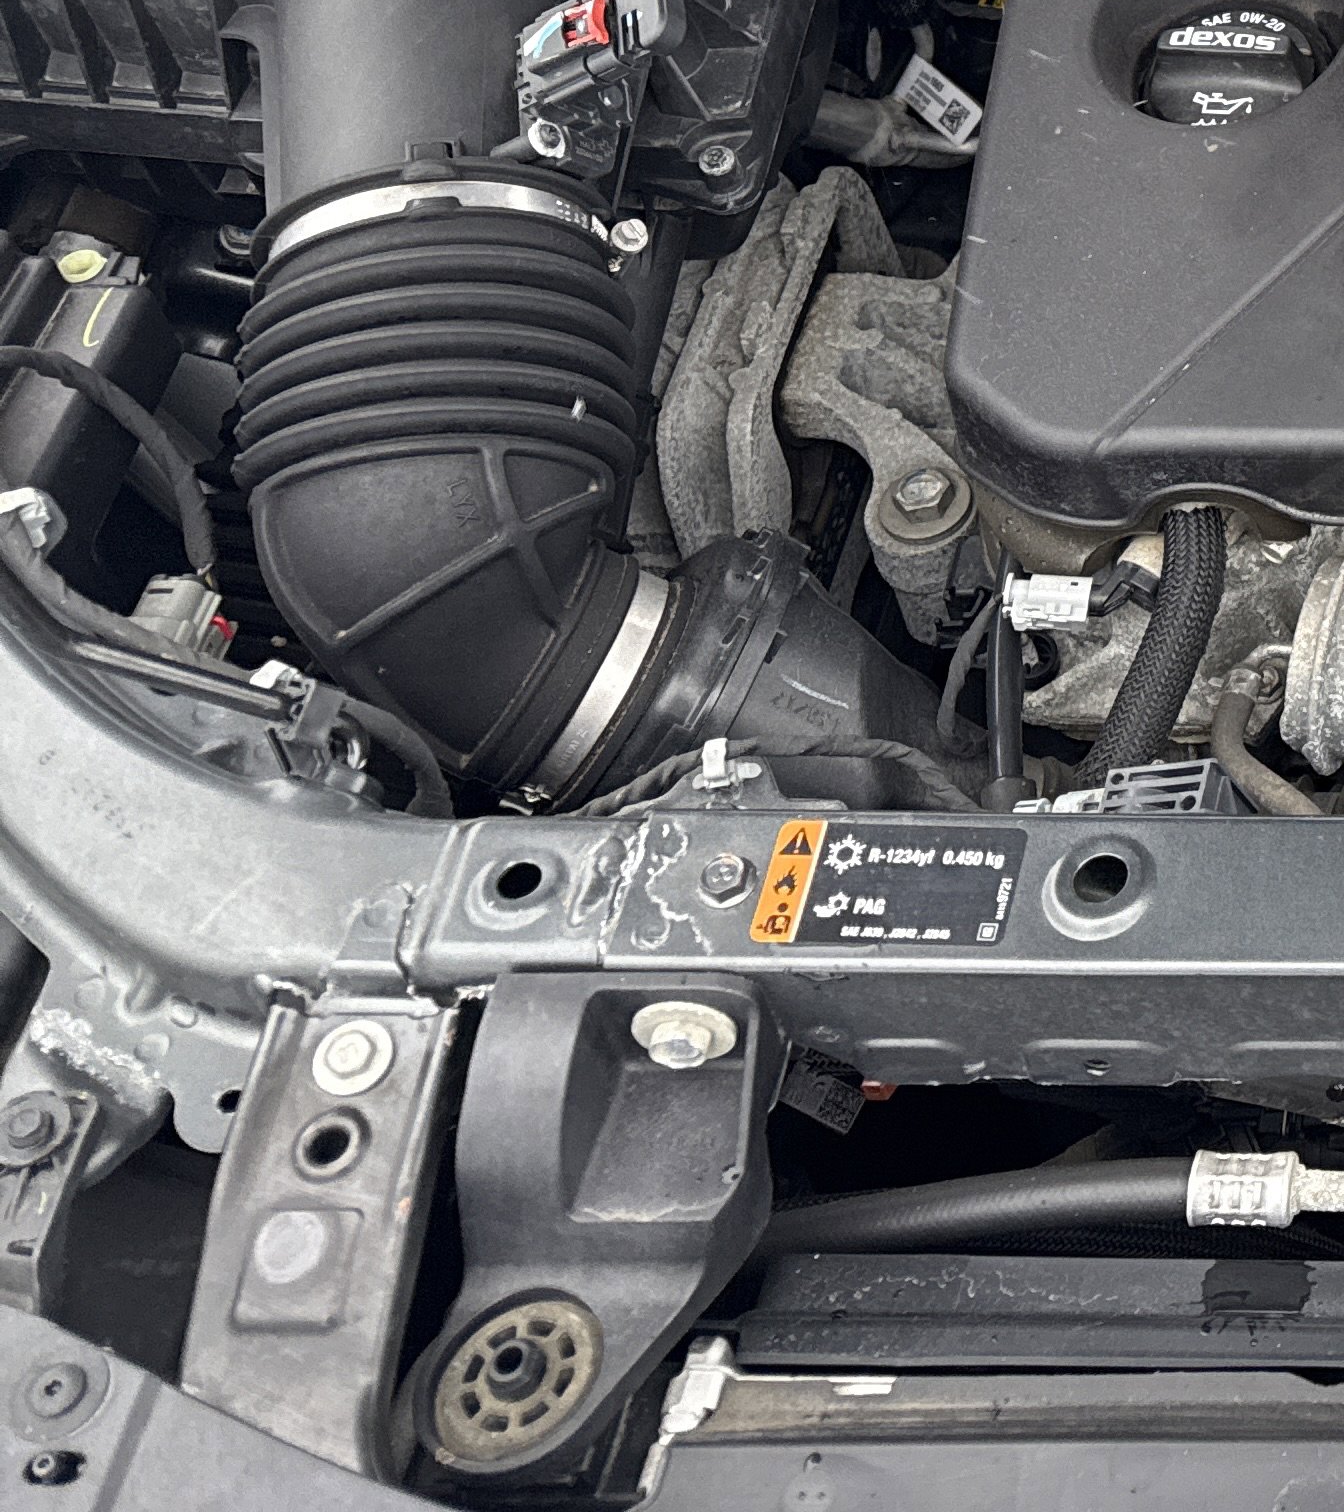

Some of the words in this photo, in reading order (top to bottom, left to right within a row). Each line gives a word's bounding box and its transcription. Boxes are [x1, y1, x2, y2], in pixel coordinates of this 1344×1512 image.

[1202, 12, 1232, 26] SAE
[1240, 12, 1286, 32] 0W-20
[1169, 27, 1276, 50] dexos
[868, 848, 936, 865] R-1234yf
[942, 850, 983, 866] 0.450
[985, 852, 1005, 870] kg
[852, 898, 886, 916] PAG
